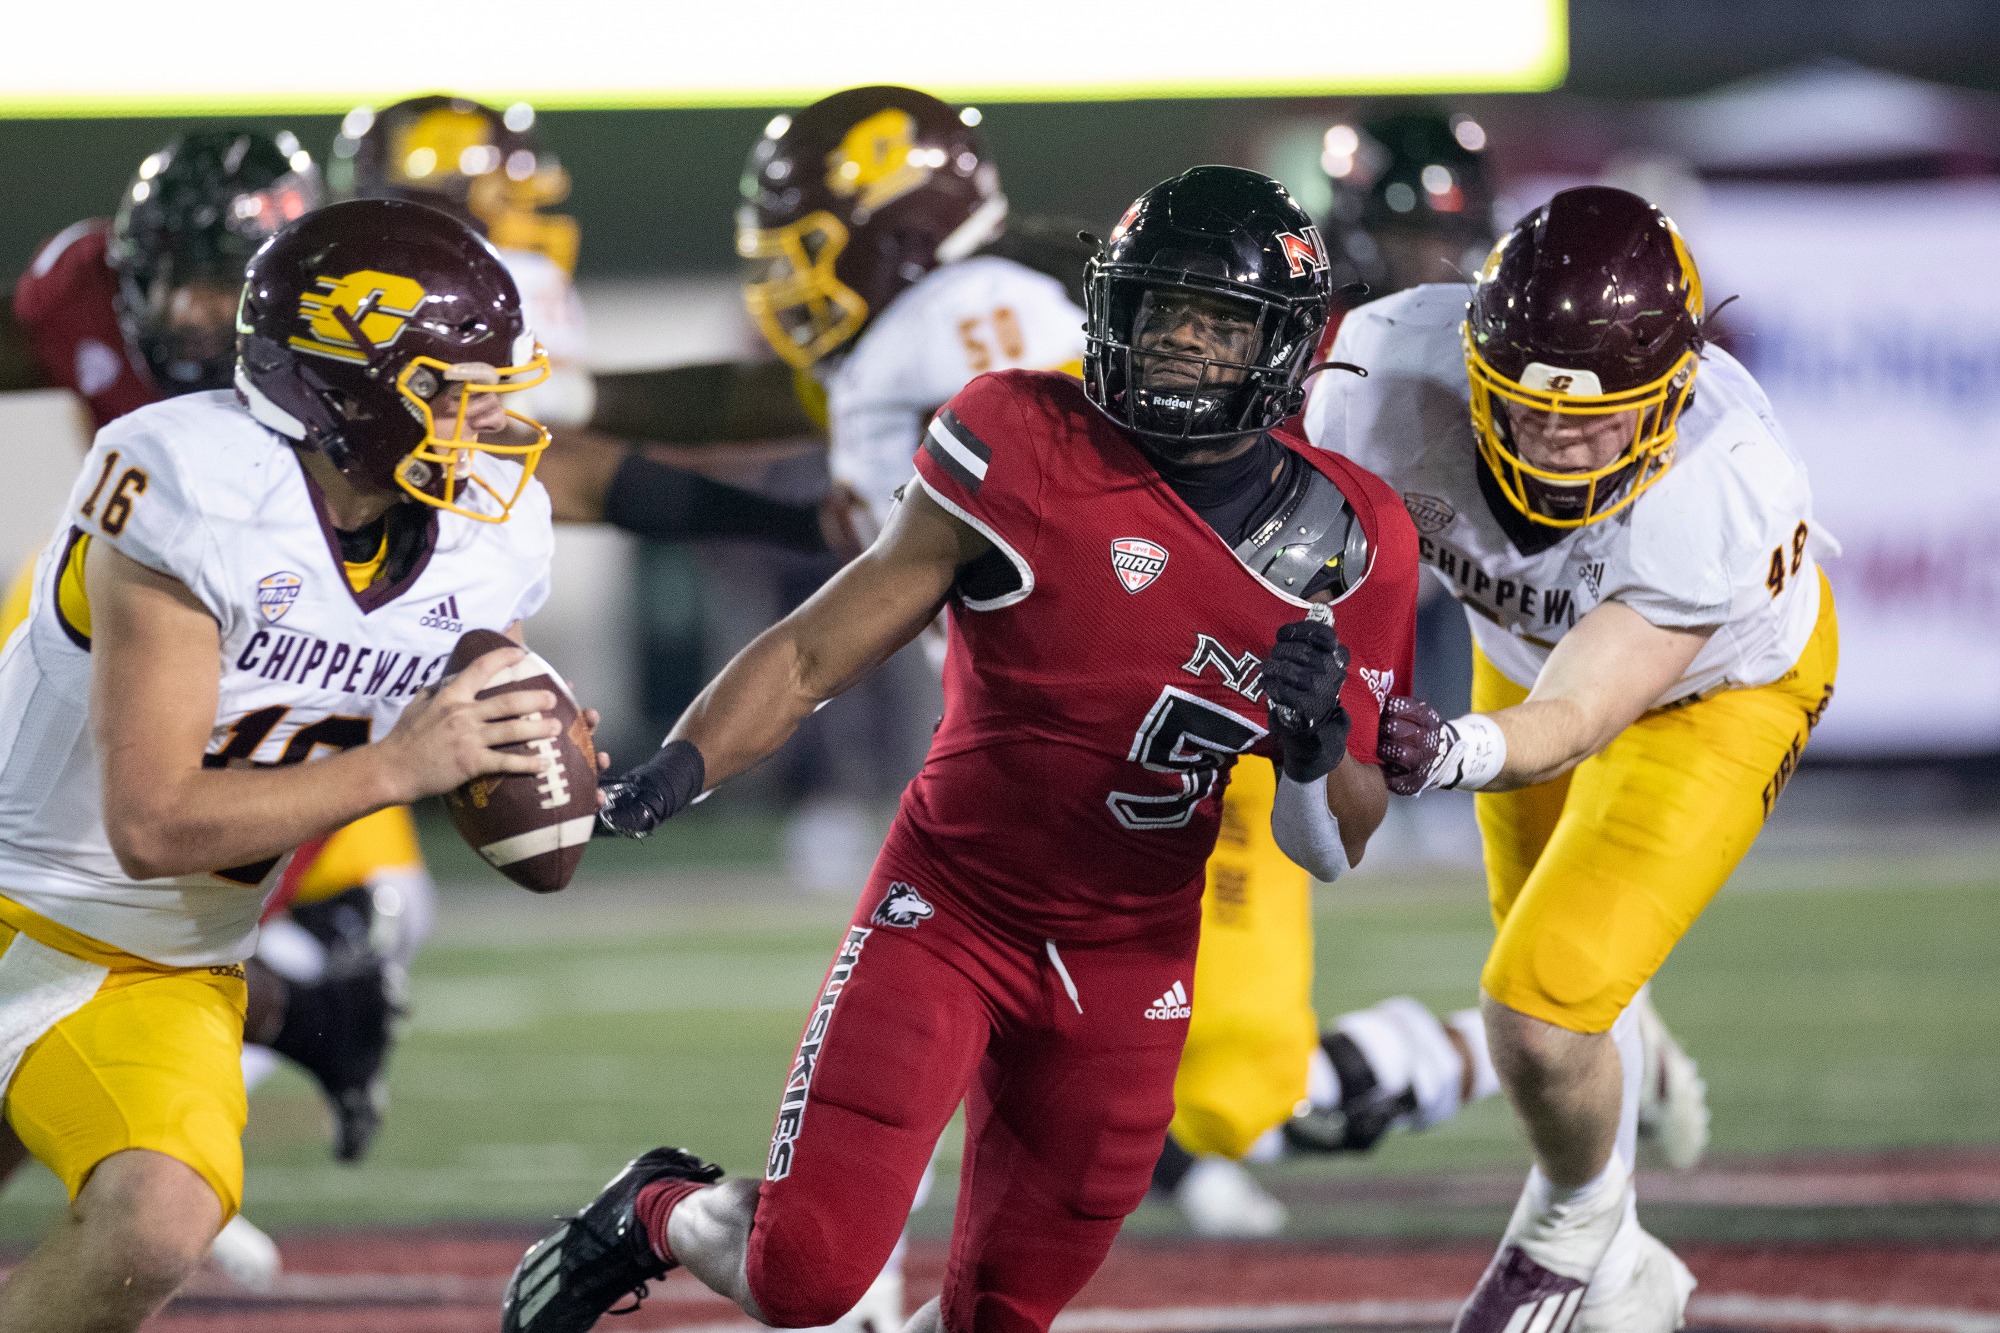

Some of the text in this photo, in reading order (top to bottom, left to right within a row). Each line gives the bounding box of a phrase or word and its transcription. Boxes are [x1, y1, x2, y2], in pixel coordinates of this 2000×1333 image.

[80, 448, 150, 538] 16
[1114, 551, 1163, 574] MAC
[1765, 519, 1809, 600] 48
[1106, 684, 1270, 830] 5
[766, 925, 874, 1183] HUSKIES
[1143, 1004, 1192, 1021] adidas
